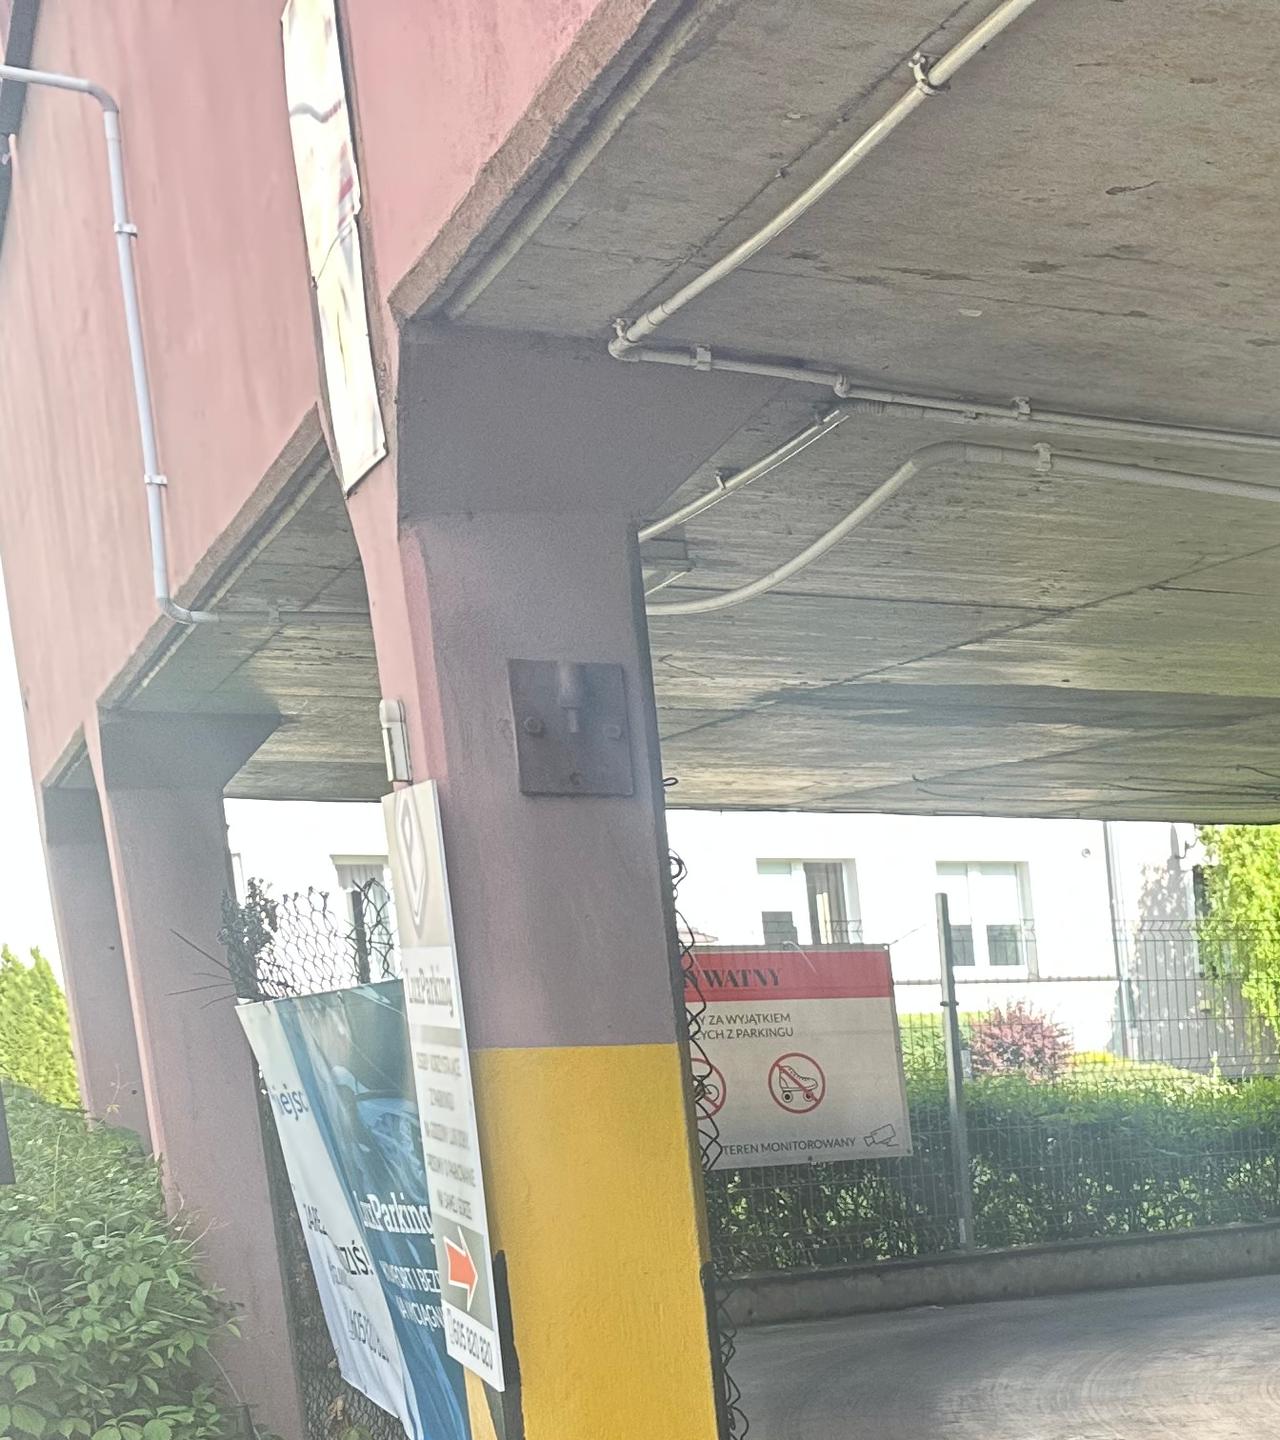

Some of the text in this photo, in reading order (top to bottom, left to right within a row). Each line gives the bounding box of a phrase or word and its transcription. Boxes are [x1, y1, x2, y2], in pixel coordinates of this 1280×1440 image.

[708, 1014, 724, 1026] ZA
[725, 1013, 791, 1025] WYJĄTKIEM
[727, 1029, 735, 1040] Z
[736, 1027, 794, 1039] PARKINGU
[722, 1136, 856, 1156] TEREN MONITOROWANY
